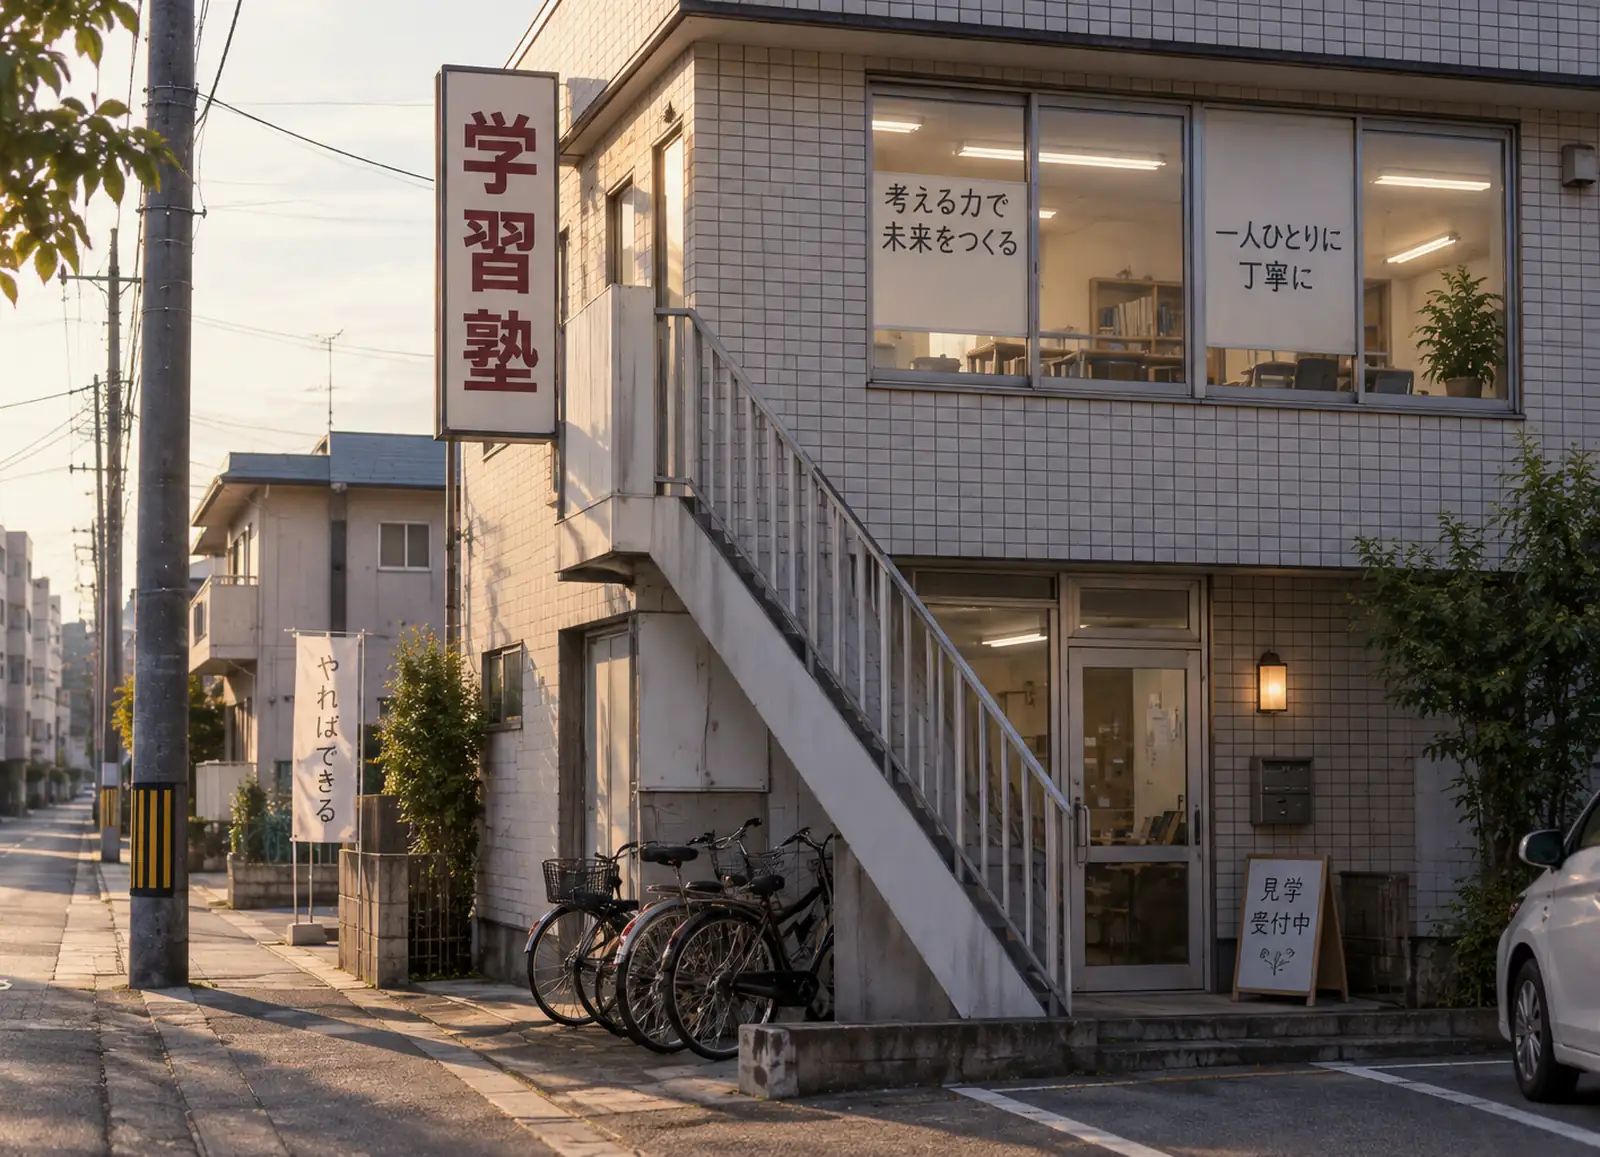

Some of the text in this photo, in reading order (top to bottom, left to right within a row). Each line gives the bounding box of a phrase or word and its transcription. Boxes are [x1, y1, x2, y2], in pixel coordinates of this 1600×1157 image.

[884, 183, 1009, 218] 考える力で
[463, 111, 539, 393] 学習塾
[882, 221, 1018, 256] 未来をつくる
[1215, 220, 1342, 252] 一人ひとりに
[1239, 260, 1313, 293] 丁寧に
[316, 655, 340, 823] やればできる
[1260, 877, 1303, 903] 見学
